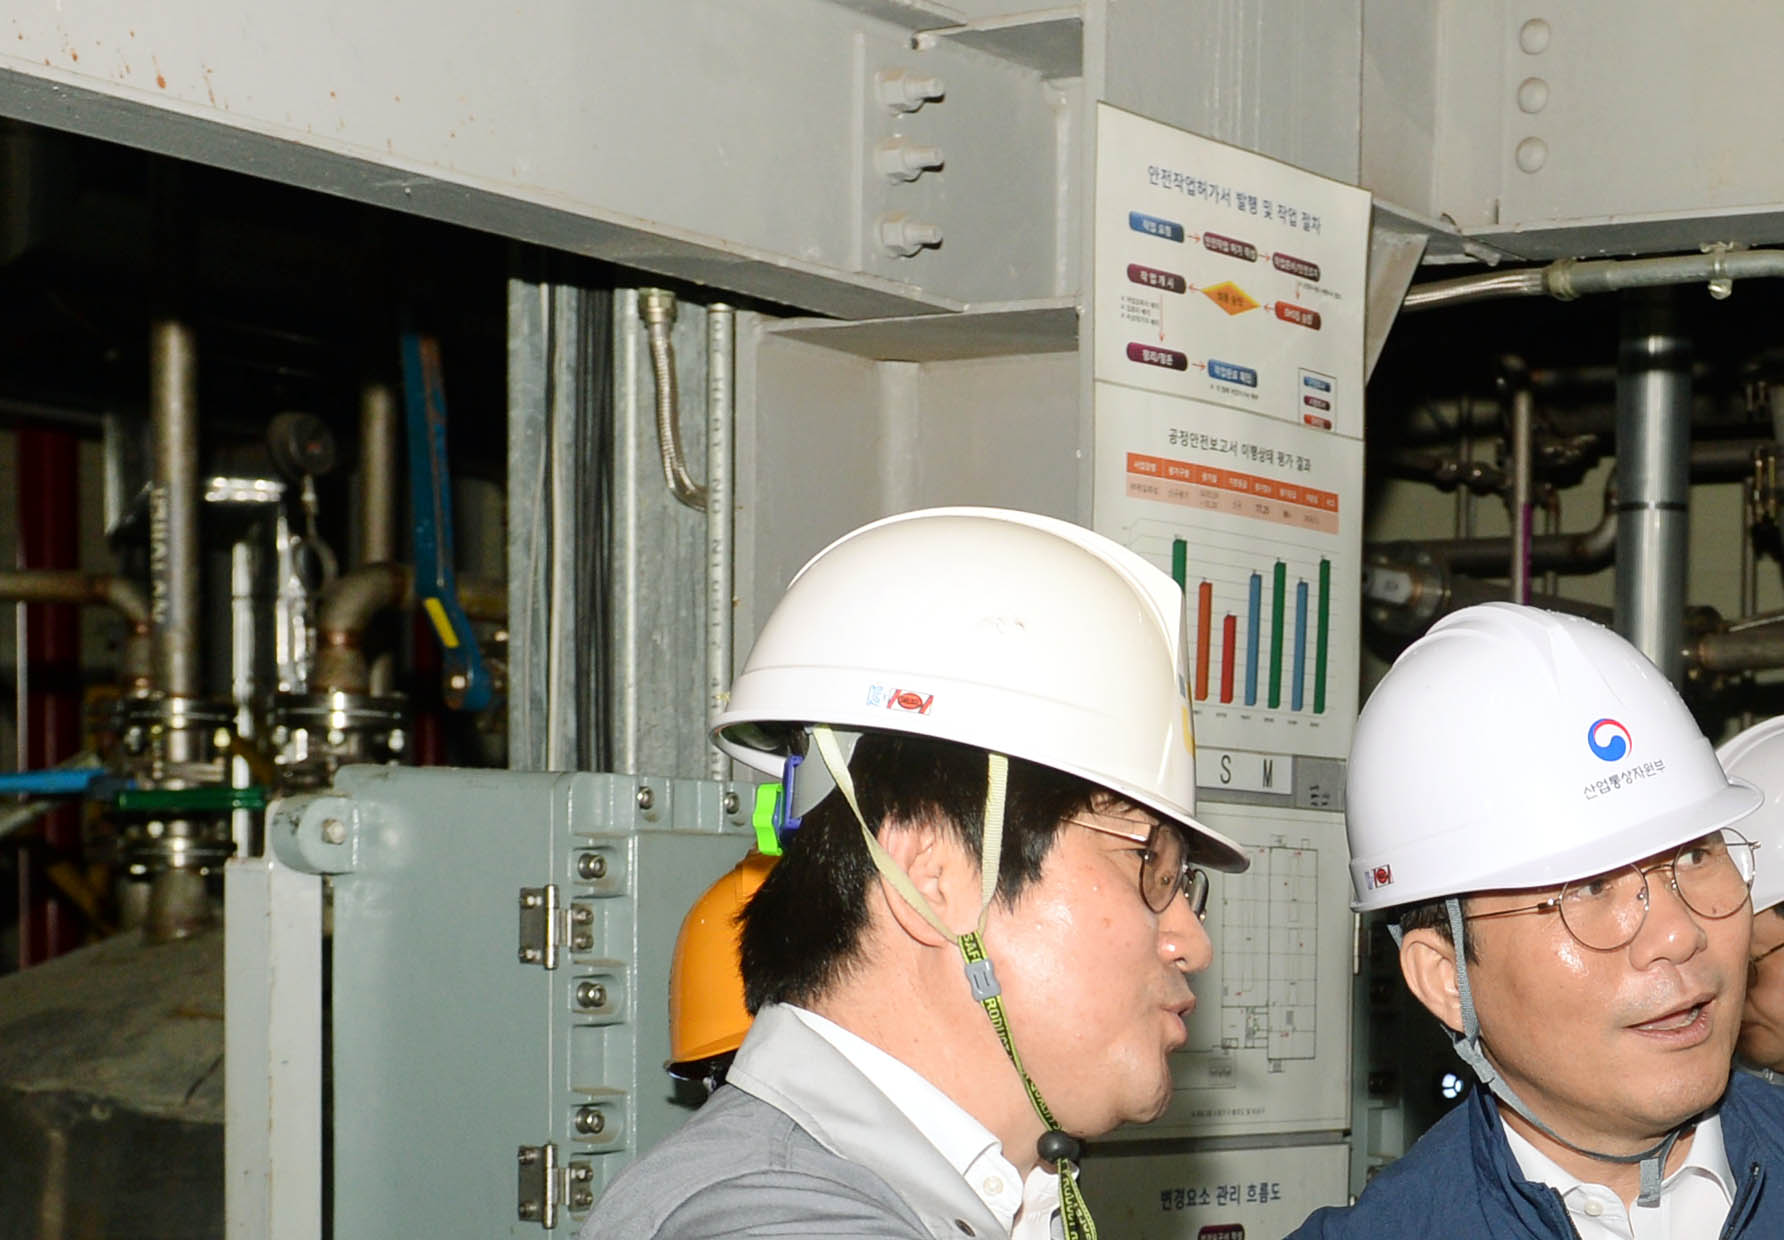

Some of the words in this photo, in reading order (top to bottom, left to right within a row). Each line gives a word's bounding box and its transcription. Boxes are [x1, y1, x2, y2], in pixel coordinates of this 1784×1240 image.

[1147, 165, 1232, 207] 안전작업허가서
[1168, 428, 1238, 456] 공정안전보고서
[1220, 754, 1231, 784] S
[1263, 758, 1273, 788] M
[1584, 759, 1666, 800] 산업통상자원부
[1160, 1188, 1210, 1211] 변경요소
[1216, 1184, 1241, 1207] 관리
[1246, 1182, 1281, 1203] 흐름도
